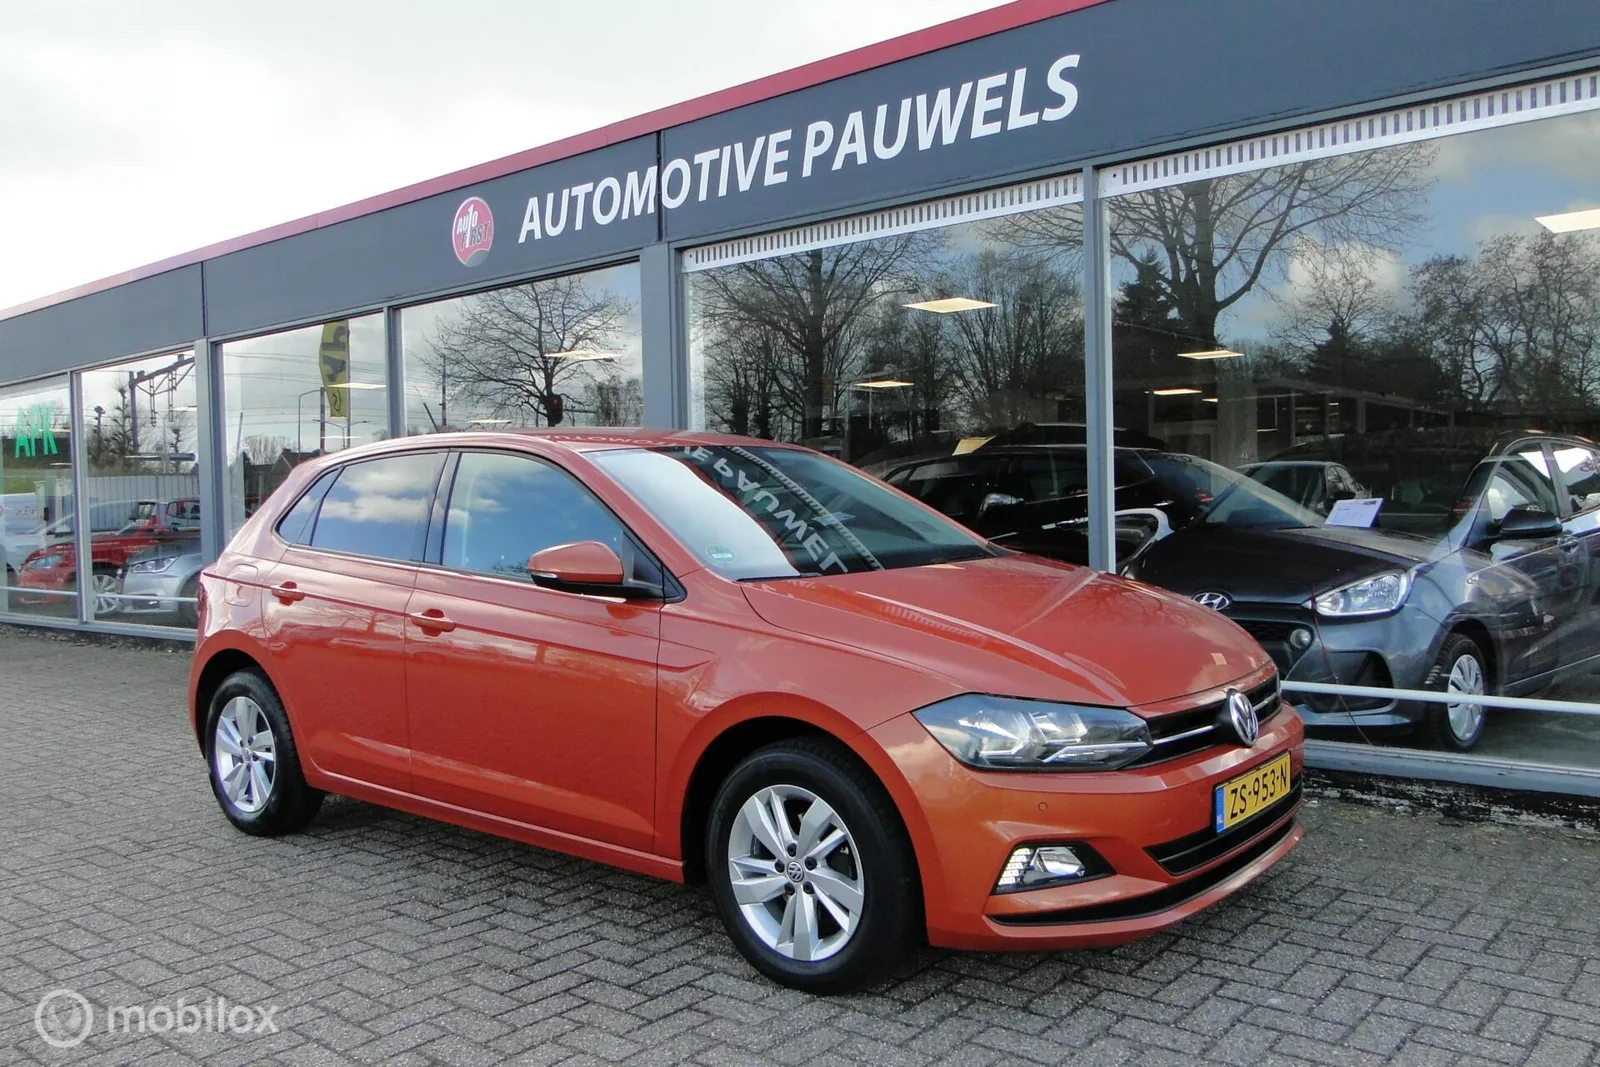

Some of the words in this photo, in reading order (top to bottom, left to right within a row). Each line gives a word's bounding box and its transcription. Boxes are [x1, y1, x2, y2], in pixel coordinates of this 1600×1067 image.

[518, 129, 793, 243] AUTOMOTIVE
[802, 54, 1081, 178] PAUWELS
[15, 400, 58, 458] APK
[1230, 761, 1288, 820] ZS-953-N
